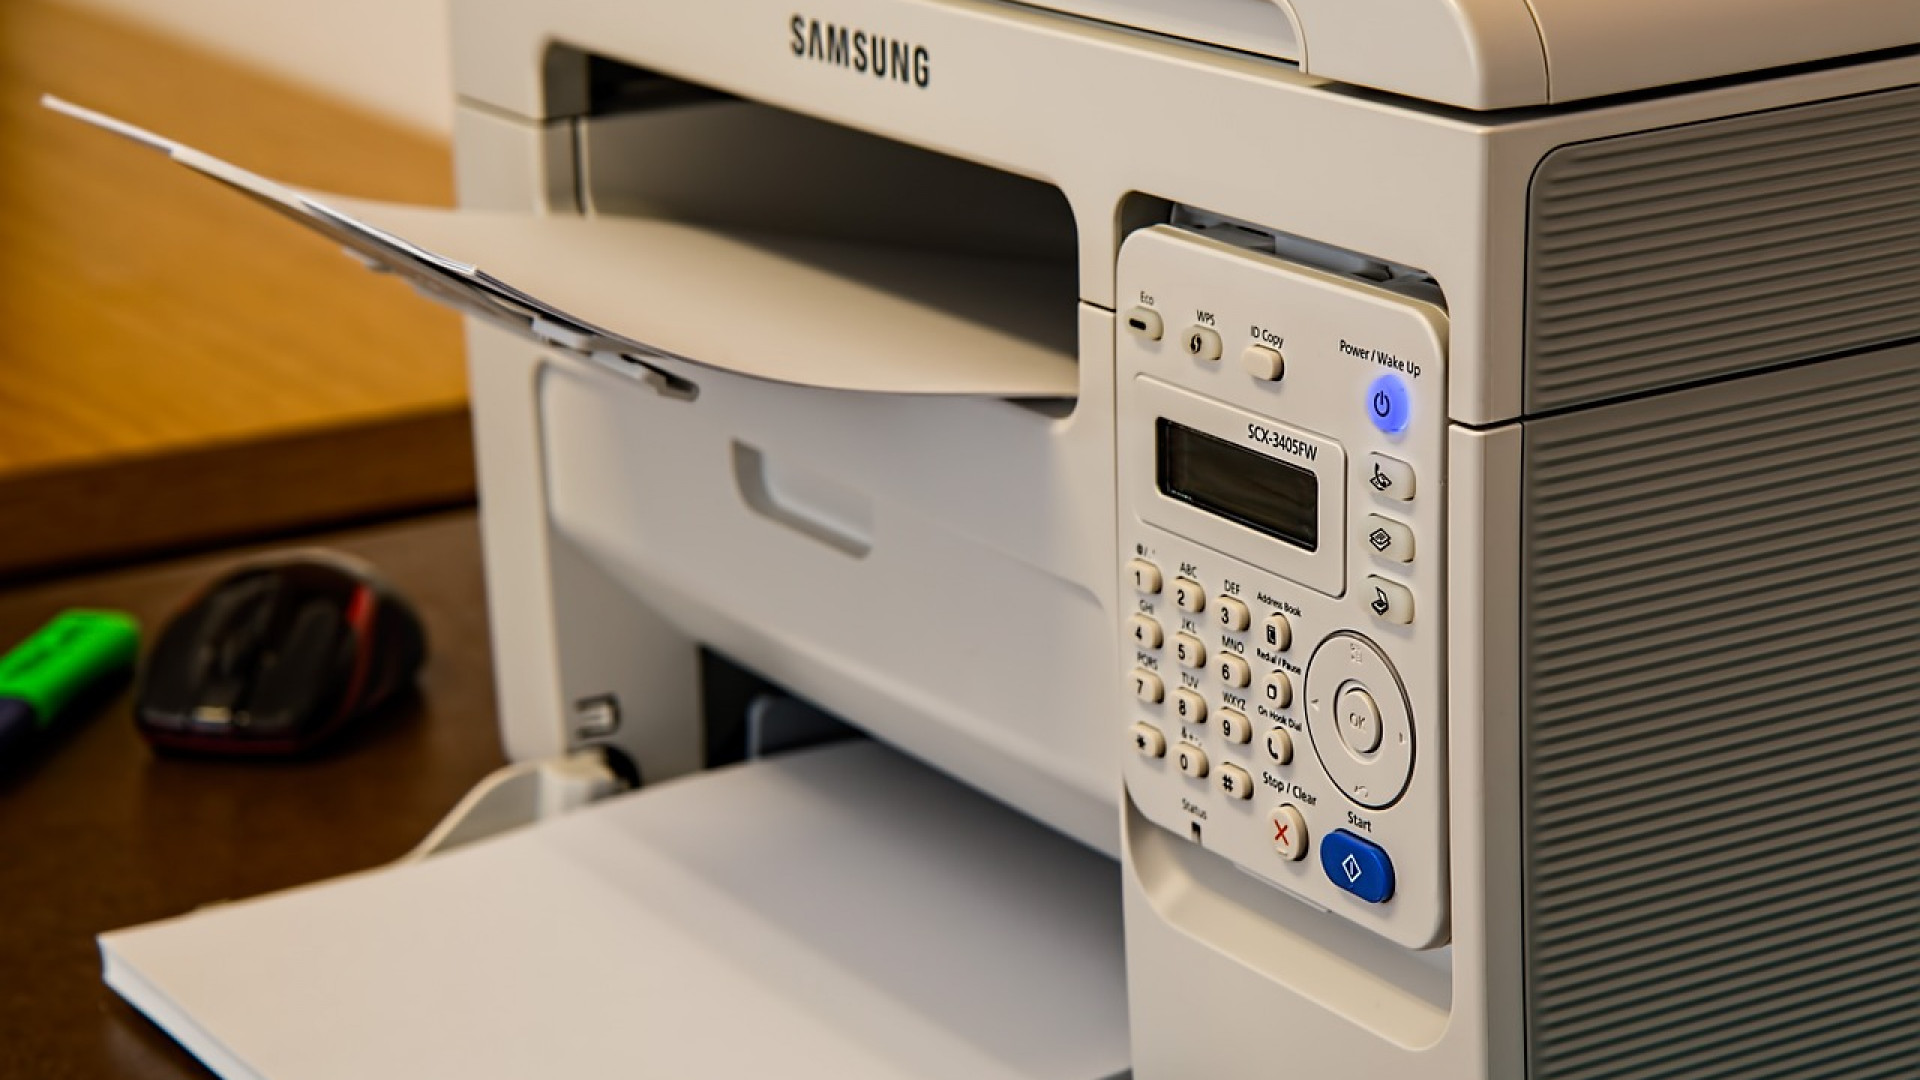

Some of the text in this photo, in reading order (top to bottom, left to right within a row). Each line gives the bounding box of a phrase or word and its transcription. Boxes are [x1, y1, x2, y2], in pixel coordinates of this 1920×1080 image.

[790, 13, 930, 89] SAMSUNG
[1140, 291, 1154, 306] Eco
[1196, 309, 1215, 326] WPS
[1251, 325, 1284, 349] ID Copy
[1339, 339, 1369, 362] Power
[1376, 351, 1405, 372] Wake
[1406, 359, 1421, 377] Up
[1247, 423, 1318, 461] SCX-3405FW
[1135, 570, 1141, 586] 1
[1179, 562, 1197, 578] ABC
[1224, 579, 1240, 595] DEF
[1176, 589, 1186, 607] 2
[1256, 591, 1302, 618] Address Book
[1220, 606, 1229, 624] 3
[1178, 643, 1186, 660] 5
[1221, 636, 1244, 654] MNO
[1181, 671, 1199, 689] TUV
[1221, 663, 1230, 681] 6
[1136, 678, 1144, 694] 7
[1178, 698, 1187, 716] 8
[1223, 691, 1246, 711] WXYZ
[1258, 705, 1268, 717] On
[1269, 710, 1288, 725] Hook
[1223, 719, 1231, 737] 9
[1179, 753, 1188, 771] 0
[1221, 774, 1234, 793] #
[1262, 771, 1284, 793] Stop
[1292, 785, 1317, 806] Clear
[1182, 798, 1208, 820] Status
[1347, 811, 1372, 833] Start
